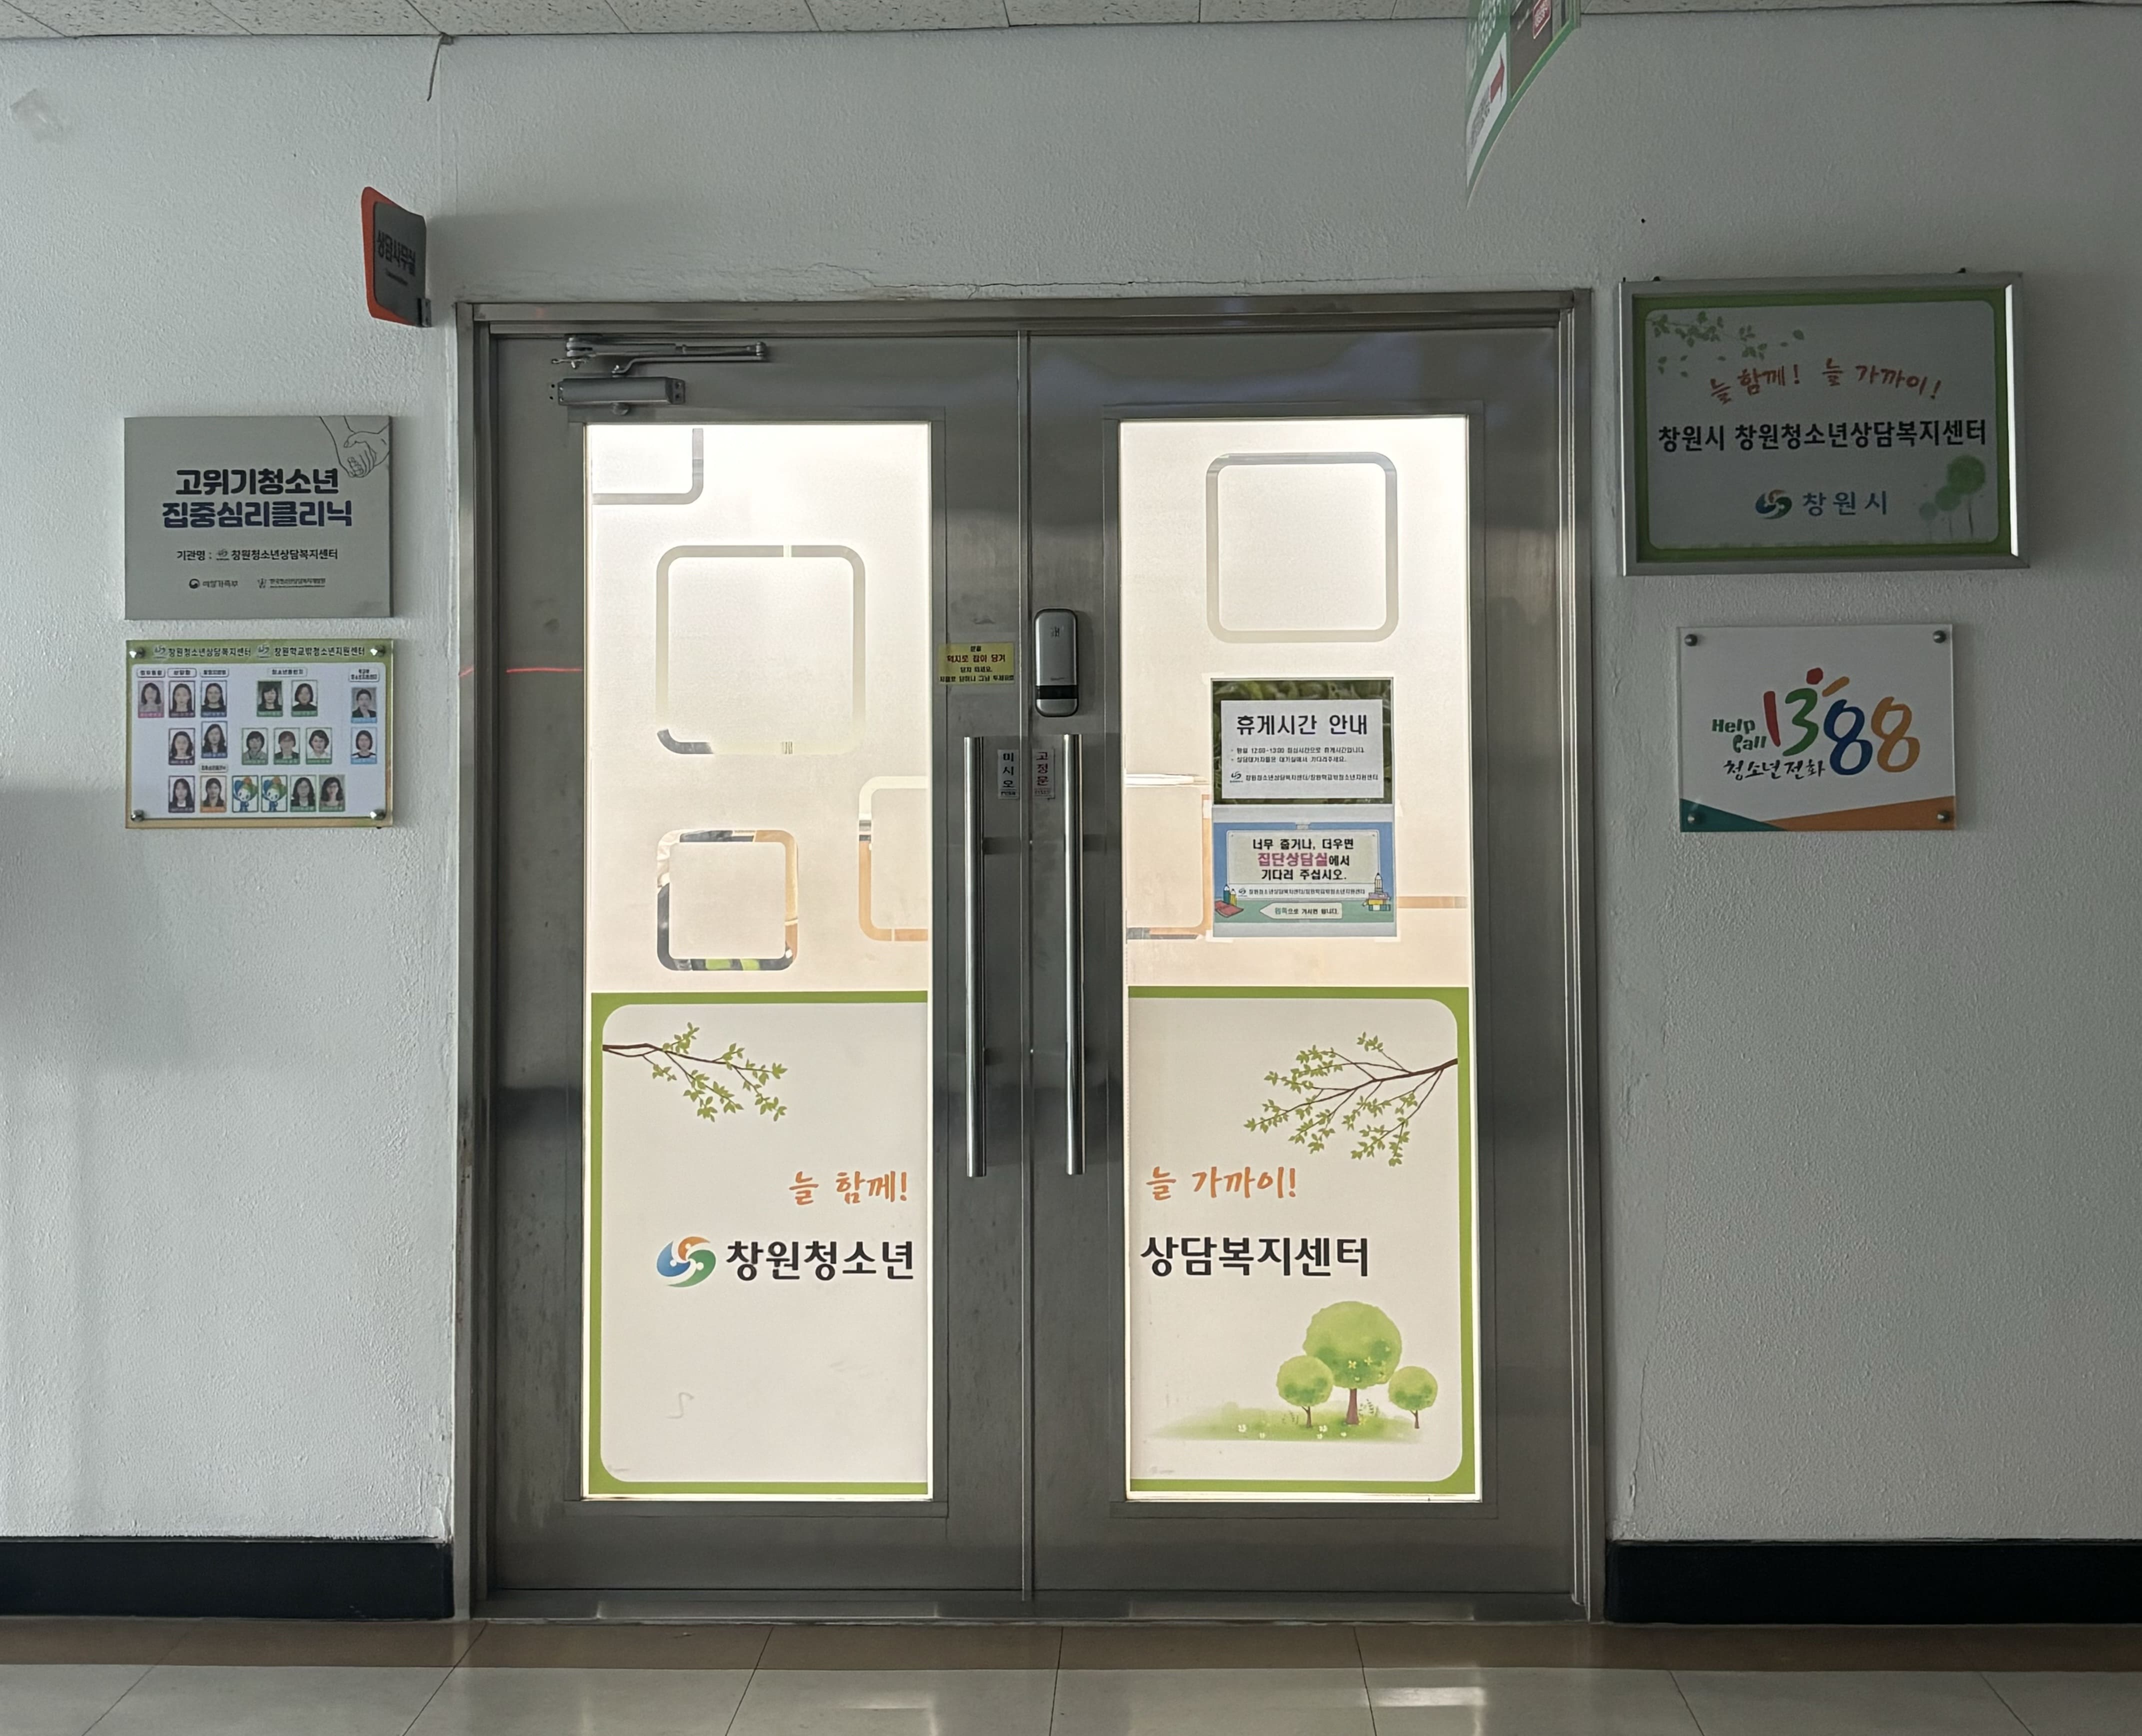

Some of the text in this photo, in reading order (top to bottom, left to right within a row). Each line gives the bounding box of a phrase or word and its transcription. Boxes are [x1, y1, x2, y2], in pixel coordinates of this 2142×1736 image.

[1710, 358, 1942, 404] 늘 함께! 늘 가까이!
[1658, 419, 1986, 452] 창원시 창원청소년상담복지센터
[176, 468, 339, 496] 고위기청소년
[162, 500, 352, 528] 집중심리클리닉
[1802, 490, 1886, 516] 창원시
[176, 550, 206, 561] 기관명
[231, 548, 338, 560] 창원청소년상담복지센터
[168, 644, 251, 658] 창원청소년상담복지센터
[1236, 714, 1367, 736] 휴게시간 안내
[1712, 718, 1756, 736] Help
[1732, 734, 1767, 754] Call
[1002, 752, 1014, 788] 미시오
[1036, 752, 1048, 786] 고정문
[1724, 758, 1826, 781] 청소년 전화
[1253, 838, 1274, 850] 너무
[1322, 838, 1354, 850] 더우면
[1258, 852, 1350, 866] 집단상담실에서
[1262, 869, 1346, 880] 기다려 주십시오.
[789, 1170, 907, 1206] 늘 함께!
[1146, 1166, 1296, 1200] 늘 가까이!
[726, 1240, 914, 1281] 창원청소년
[1140, 1236, 1368, 1277] 상담복지센터
